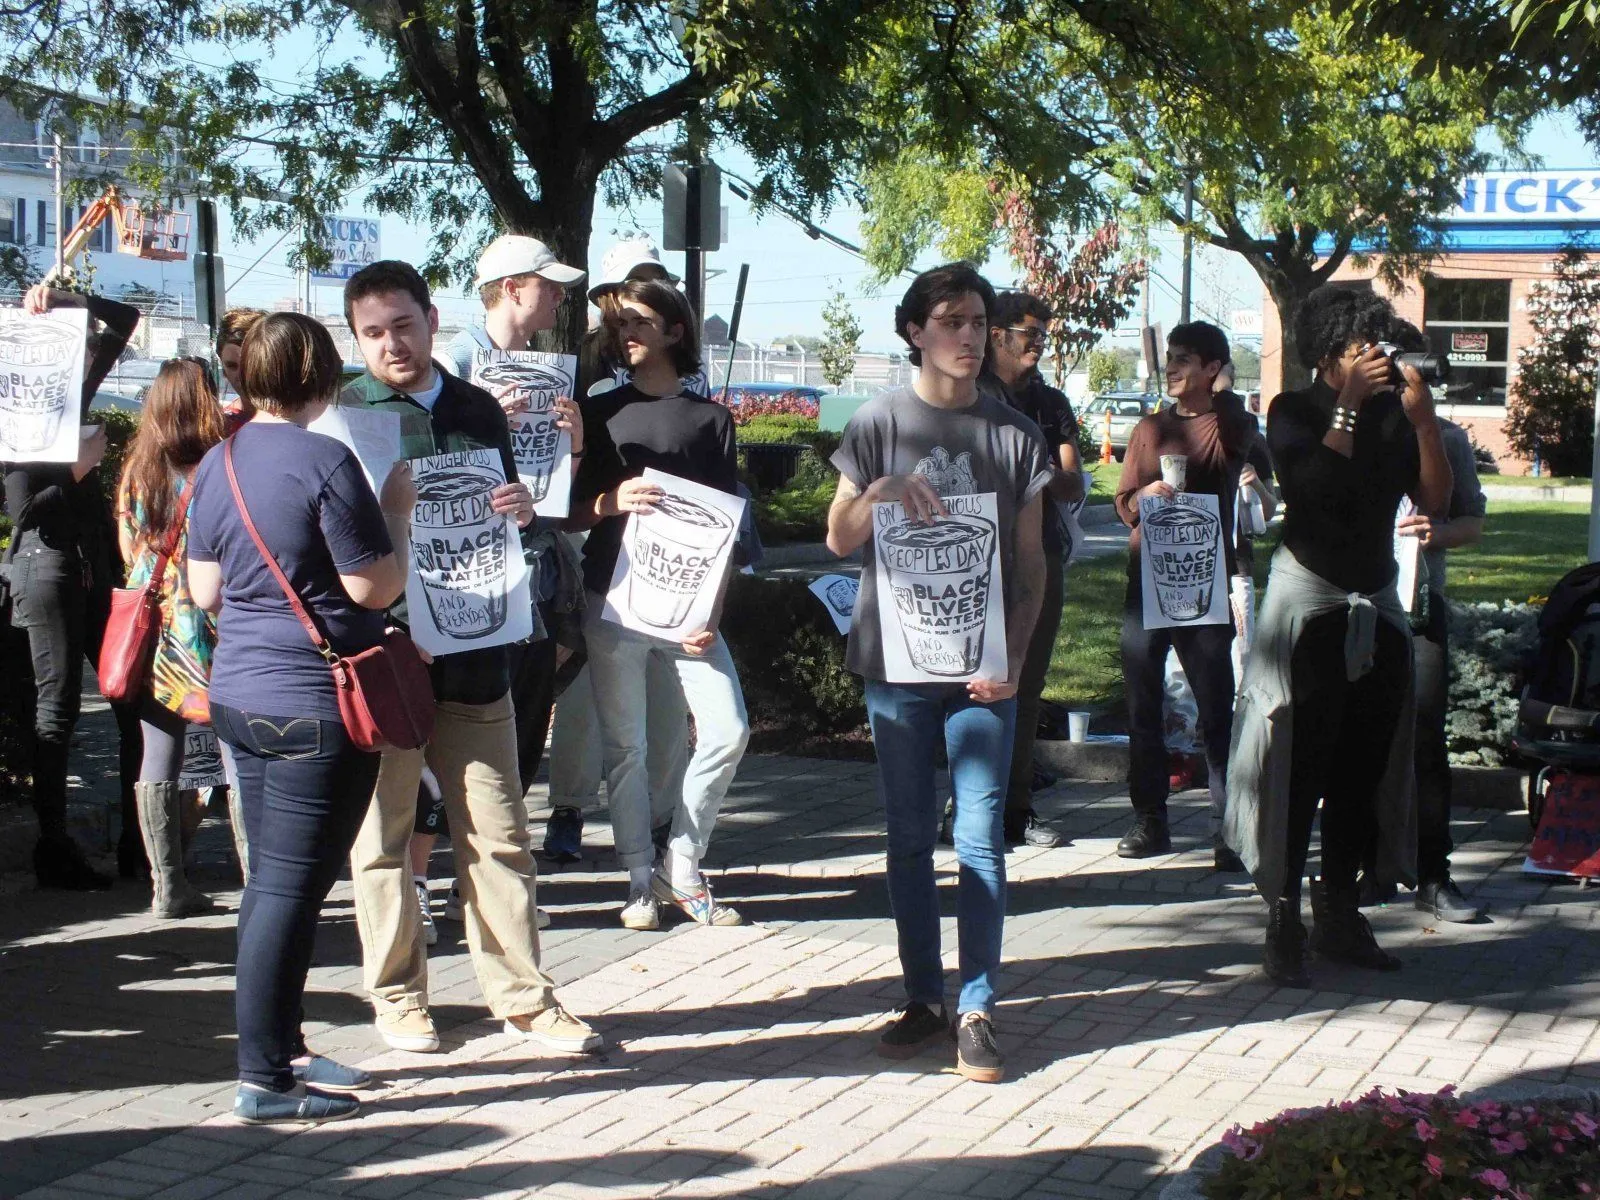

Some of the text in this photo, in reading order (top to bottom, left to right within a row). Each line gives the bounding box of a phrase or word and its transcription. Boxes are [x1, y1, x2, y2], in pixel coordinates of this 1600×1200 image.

[478, 349, 493, 366] ON
[10, 368, 73, 387] BLACK
[11, 382, 67, 401] LIVES
[12, 396, 65, 409] MATTER
[511, 432, 557, 449] IVES
[418, 450, 491, 475] INDIGENOUS
[514, 446, 555, 458] ATTER
[415, 498, 467, 526] EOPLES
[877, 503, 896, 528] ON
[430, 522, 506, 556] BLACK
[1147, 523, 1214, 544] PEOPLES DAY
[434, 542, 504, 572] LIVES
[651, 542, 716, 569] BLACK
[887, 535, 988, 572] PEOPLES DAY
[1163, 546, 1217, 564] BLACK
[440, 560, 504, 583] MATTER
[649, 557, 706, 581] LIVES
[1165, 558, 1214, 575] LIVES
[1167, 570, 1213, 582] MATTER
[647, 569, 700, 590] MATTER
[912, 571, 990, 601] BLACK
[437, 594, 466, 612] AND
[916, 589, 985, 617] LIVES
[919, 607, 984, 627] MATTER
[915, 637, 942, 651] AND
